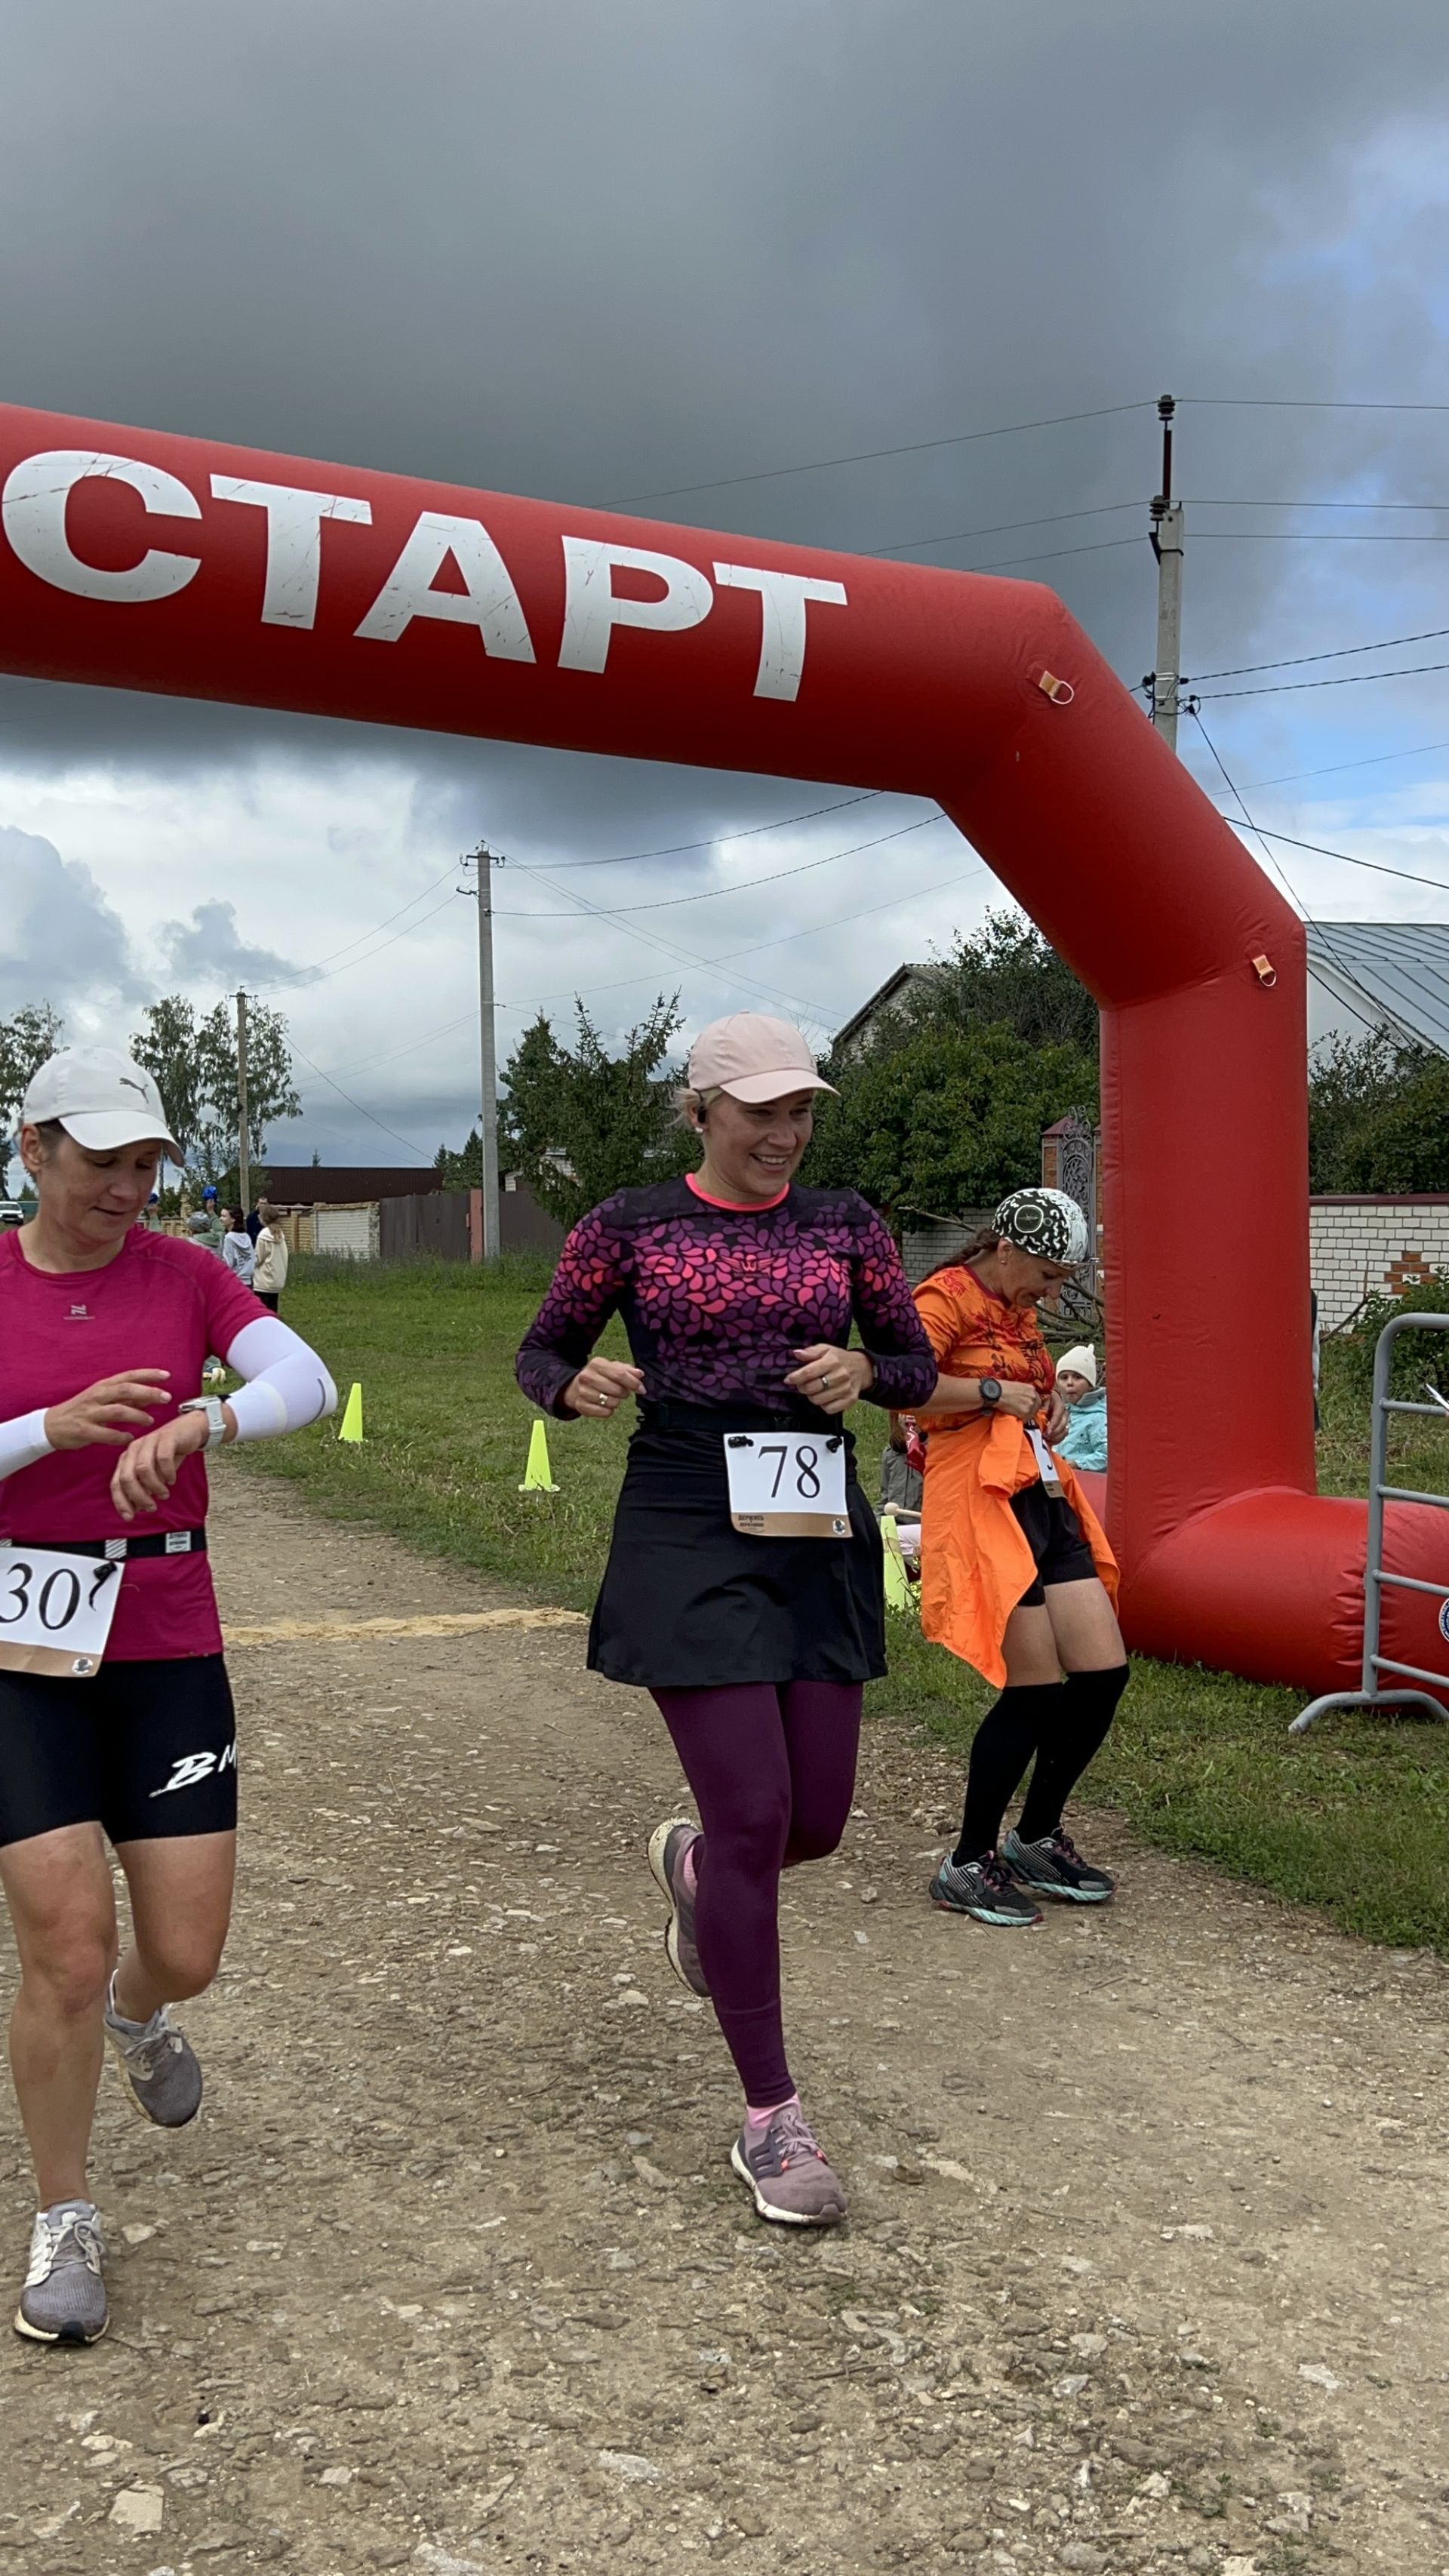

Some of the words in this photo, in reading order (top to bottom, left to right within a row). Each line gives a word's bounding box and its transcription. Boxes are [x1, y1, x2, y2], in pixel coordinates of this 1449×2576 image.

[2, 449, 848, 702] СТАРТ
[758, 1445, 821, 1499] 78
[0, 1562, 81, 1630] 30
